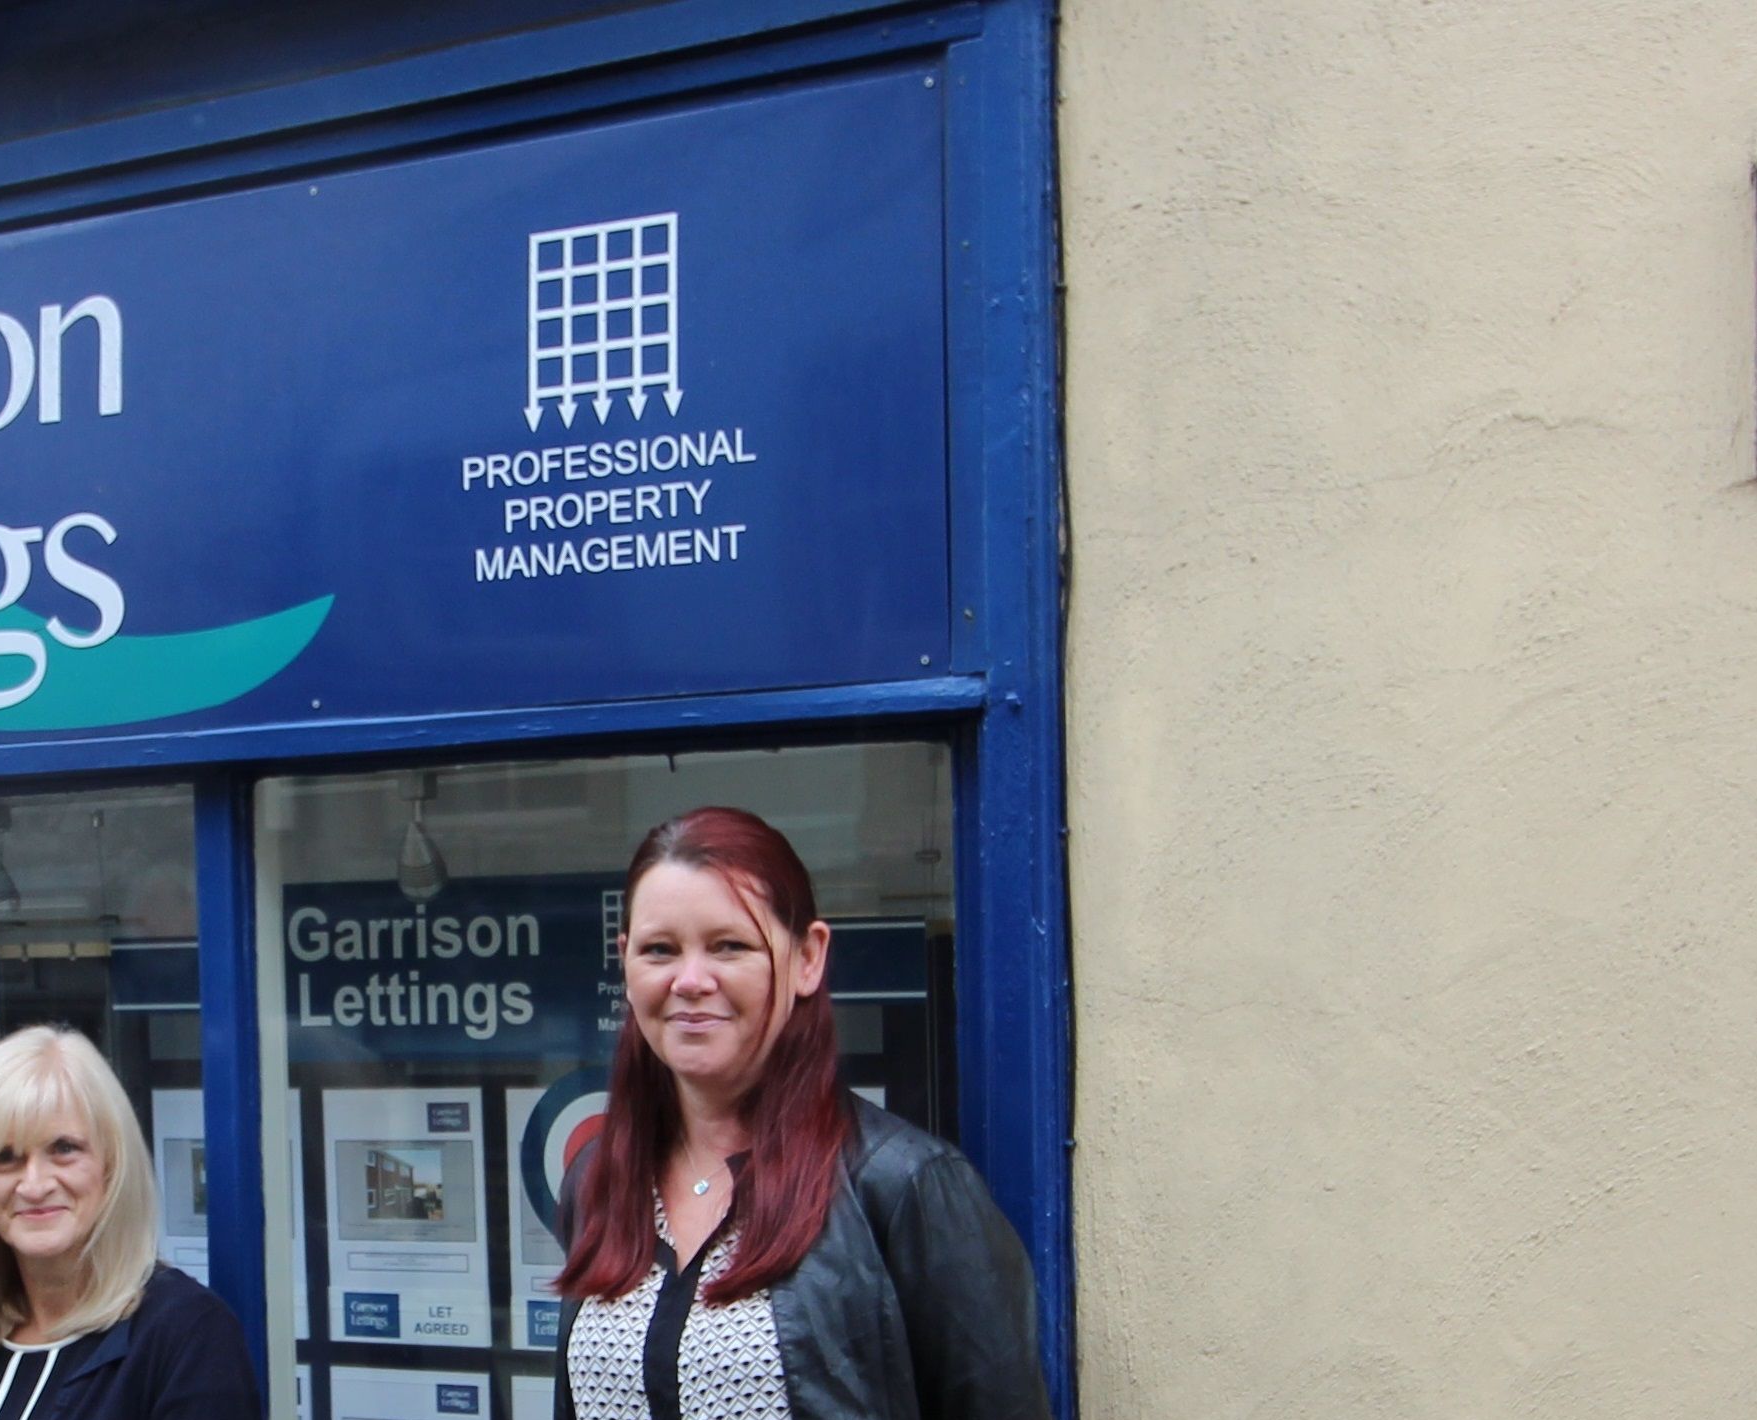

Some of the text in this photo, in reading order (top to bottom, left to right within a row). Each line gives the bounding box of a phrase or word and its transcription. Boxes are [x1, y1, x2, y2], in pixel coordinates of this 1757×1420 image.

[462, 428, 757, 491] PROFESSIONAL
[505, 479, 712, 534] PROPERTY
[475, 525, 747, 583] MANAGEMENT
[288, 904, 541, 963] Garrison
[299, 970, 535, 1041] Lettings
[413, 1322, 469, 1337] AGREED
[429, 1305, 453, 1319] LET
